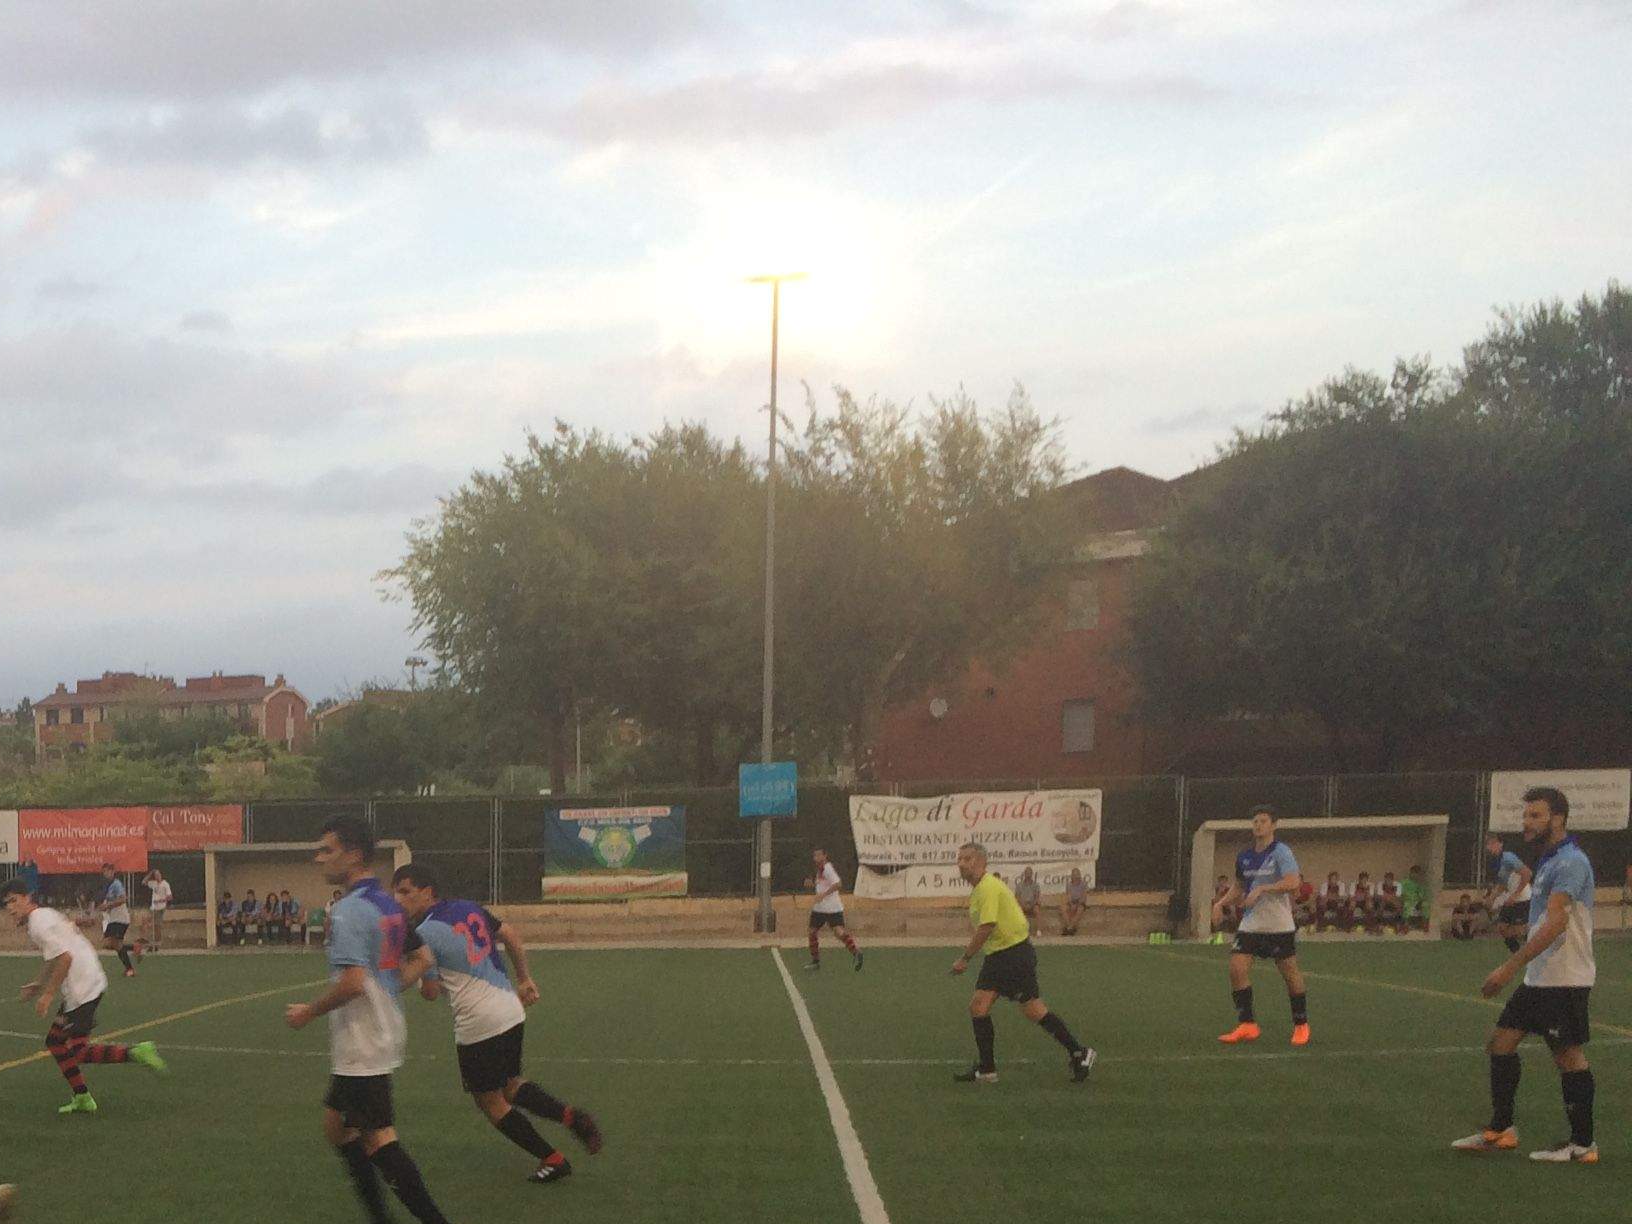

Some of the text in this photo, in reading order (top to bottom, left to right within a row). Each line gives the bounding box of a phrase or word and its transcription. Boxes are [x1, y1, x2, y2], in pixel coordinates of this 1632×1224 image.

[180, 808, 214, 827] Tony
[926, 797, 953, 821] di
[963, 793, 1044, 828] Garda
[863, 830, 1034, 845] RESTAURANTE PIZZERIA
[934, 874, 943, 888] 5
